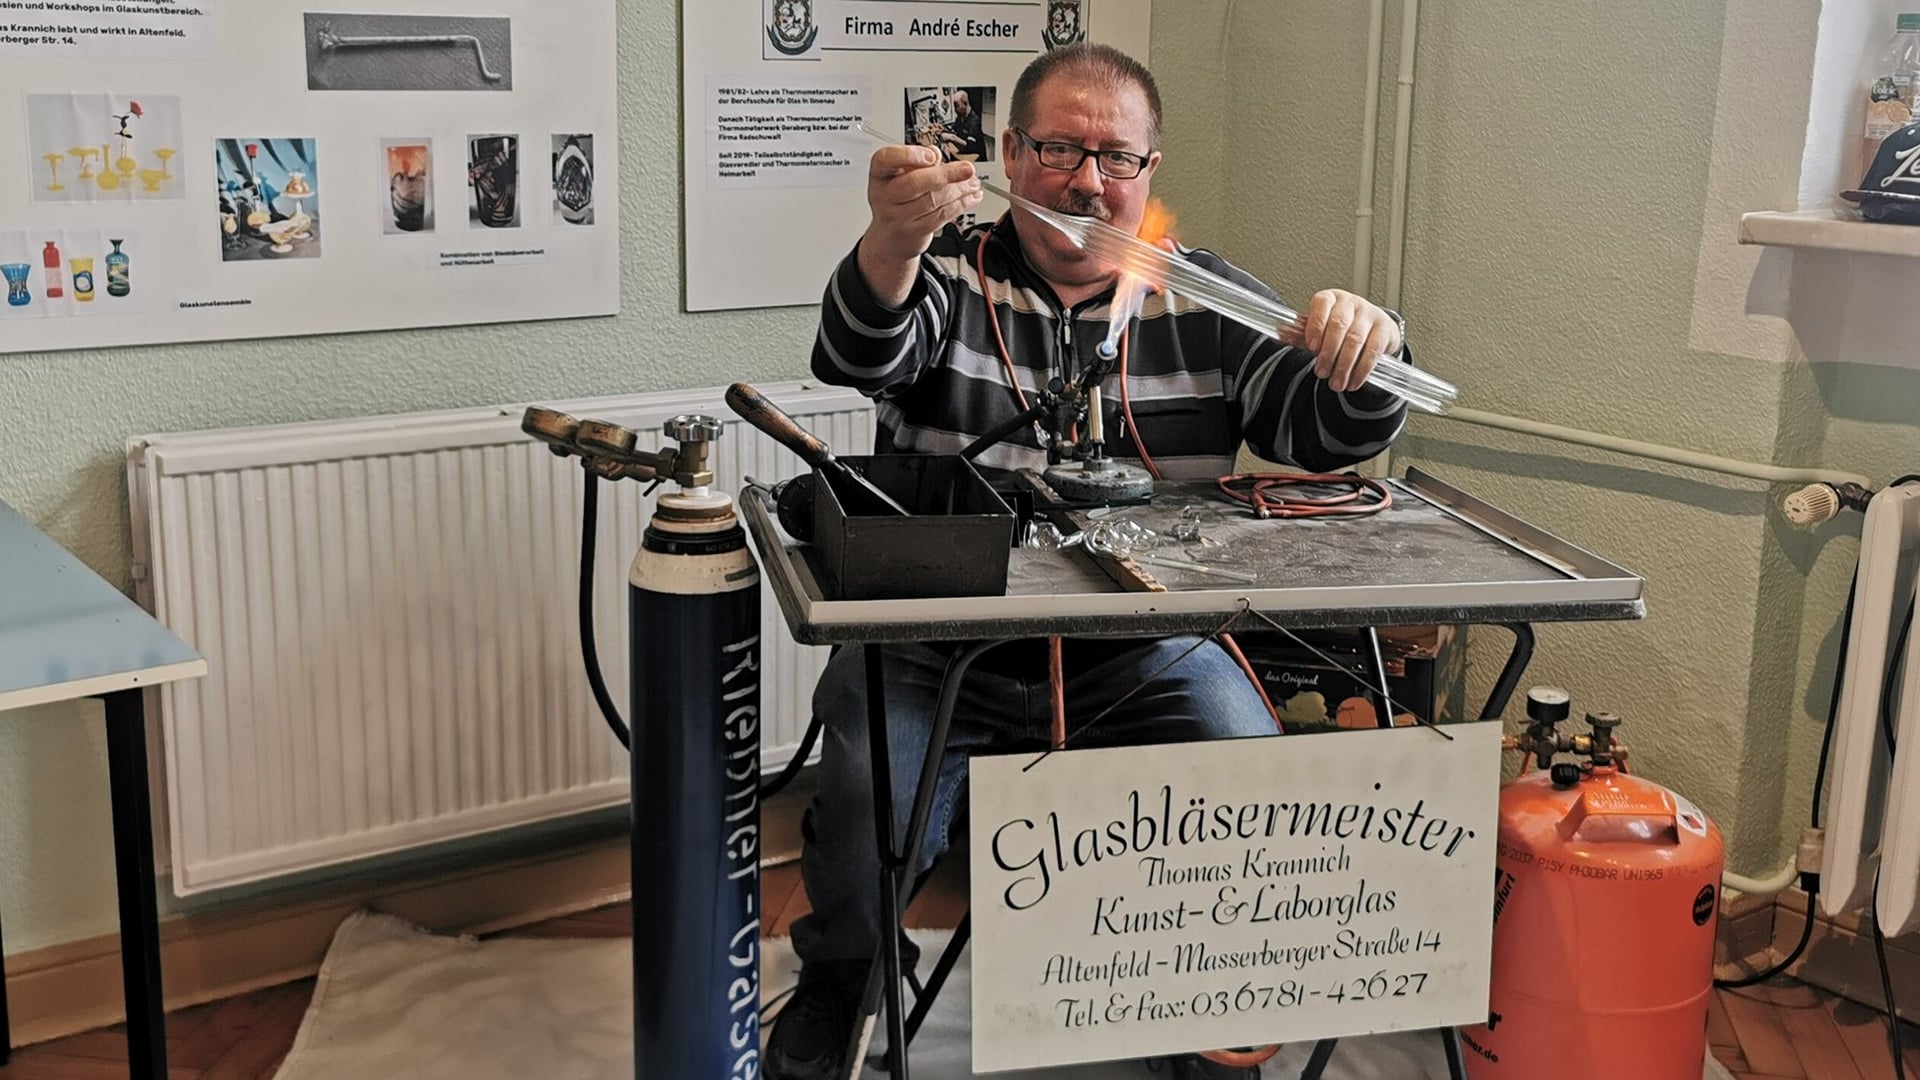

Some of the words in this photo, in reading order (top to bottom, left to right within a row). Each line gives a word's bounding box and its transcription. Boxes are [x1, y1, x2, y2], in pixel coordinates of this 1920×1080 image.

[0, 1, 23, 9] sien
[25, 2, 44, 10] und
[46, 2, 100, 12] Workshops
[102, 4, 114, 13] im
[116, 5, 203, 16] Glaskunstbereich.
[11, 24, 56, 33] Krannich
[58, 25, 78, 34] lebt
[80, 26, 98, 35] und
[100, 27, 126, 36] wirkt
[128, 28, 137, 36] in
[139, 28, 187, 38] Altenfeld.
[845, 17, 894, 36] Firma
[909, 18, 960, 37] André
[966, 20, 1019, 38] Escher
[41, 36, 60, 44] Str.
[62, 37, 77, 45] 14.
[782, 88, 849, 96] Thermometermacher
[718, 133, 738, 141] Firma
[1264, 670, 1280, 682] das
[1281, 671, 1319, 688] Original
[991, 781, 1476, 911] Glasbläsermeister
[1138, 855, 1232, 889] Thomas
[1242, 844, 1351, 880] Krannich
[1089, 895, 1204, 937] Kunst-
[1211, 884, 1249, 925] &
[1249, 878, 1397, 926] Laborglas
[1173, 938, 1332, 974] Masserberger
[1333, 927, 1410, 959] Straße
[1415, 928, 1442, 953] 14
[1054, 997, 1099, 1028] Tel.
[1104, 991, 1133, 1023] &
